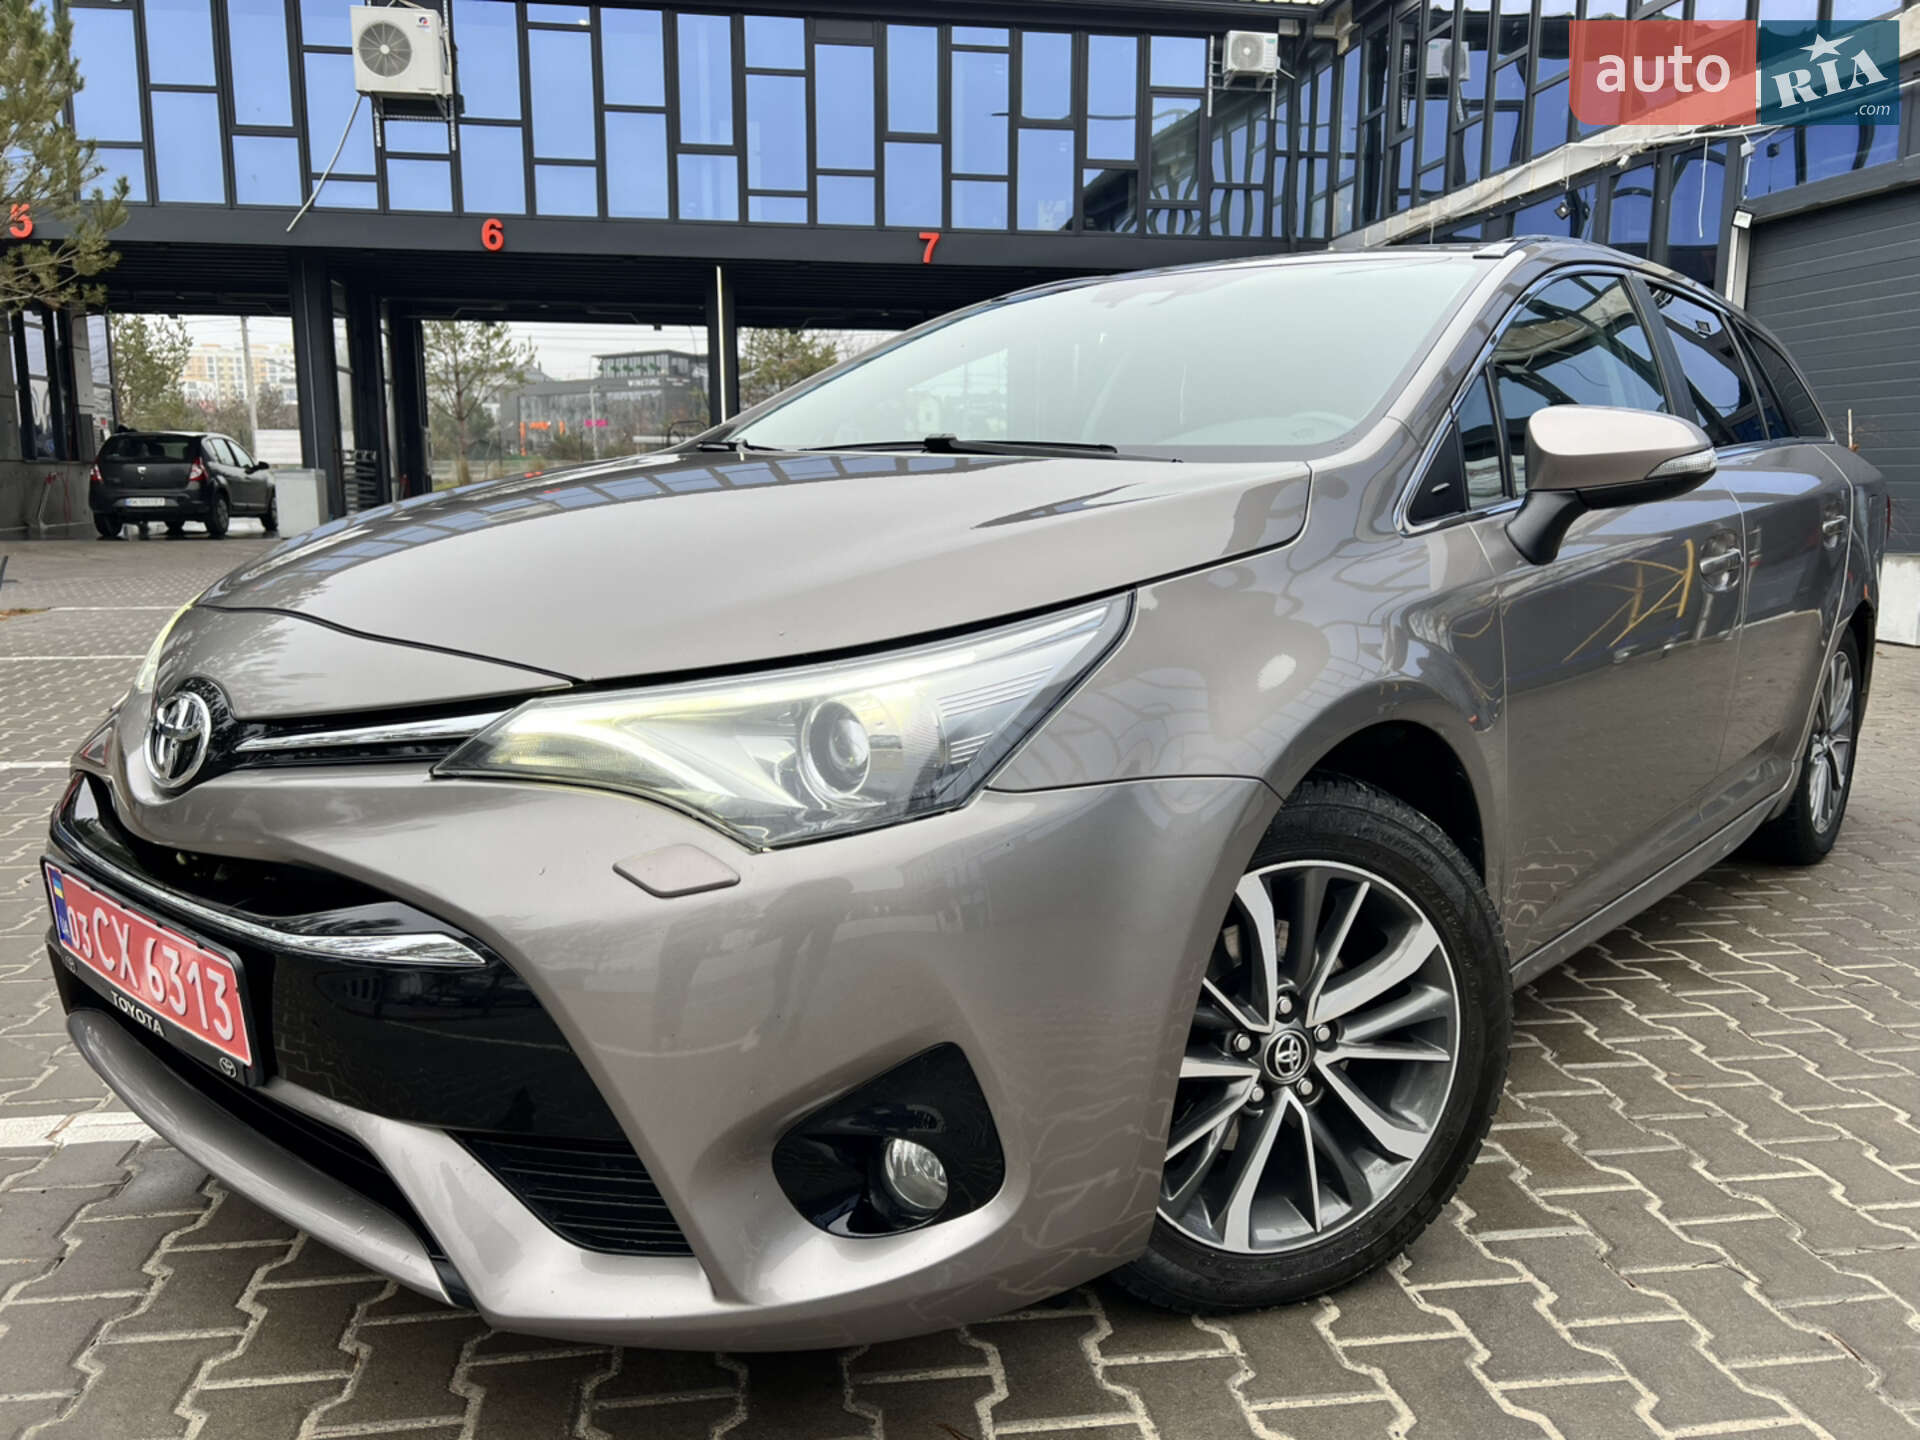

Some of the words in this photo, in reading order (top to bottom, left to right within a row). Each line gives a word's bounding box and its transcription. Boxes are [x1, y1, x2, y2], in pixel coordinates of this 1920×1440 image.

[10, 203, 33, 239] 5
[481, 217, 504, 251] 6
[918, 231, 940, 264] 7
[110, 991, 164, 1037] TOYOTA
